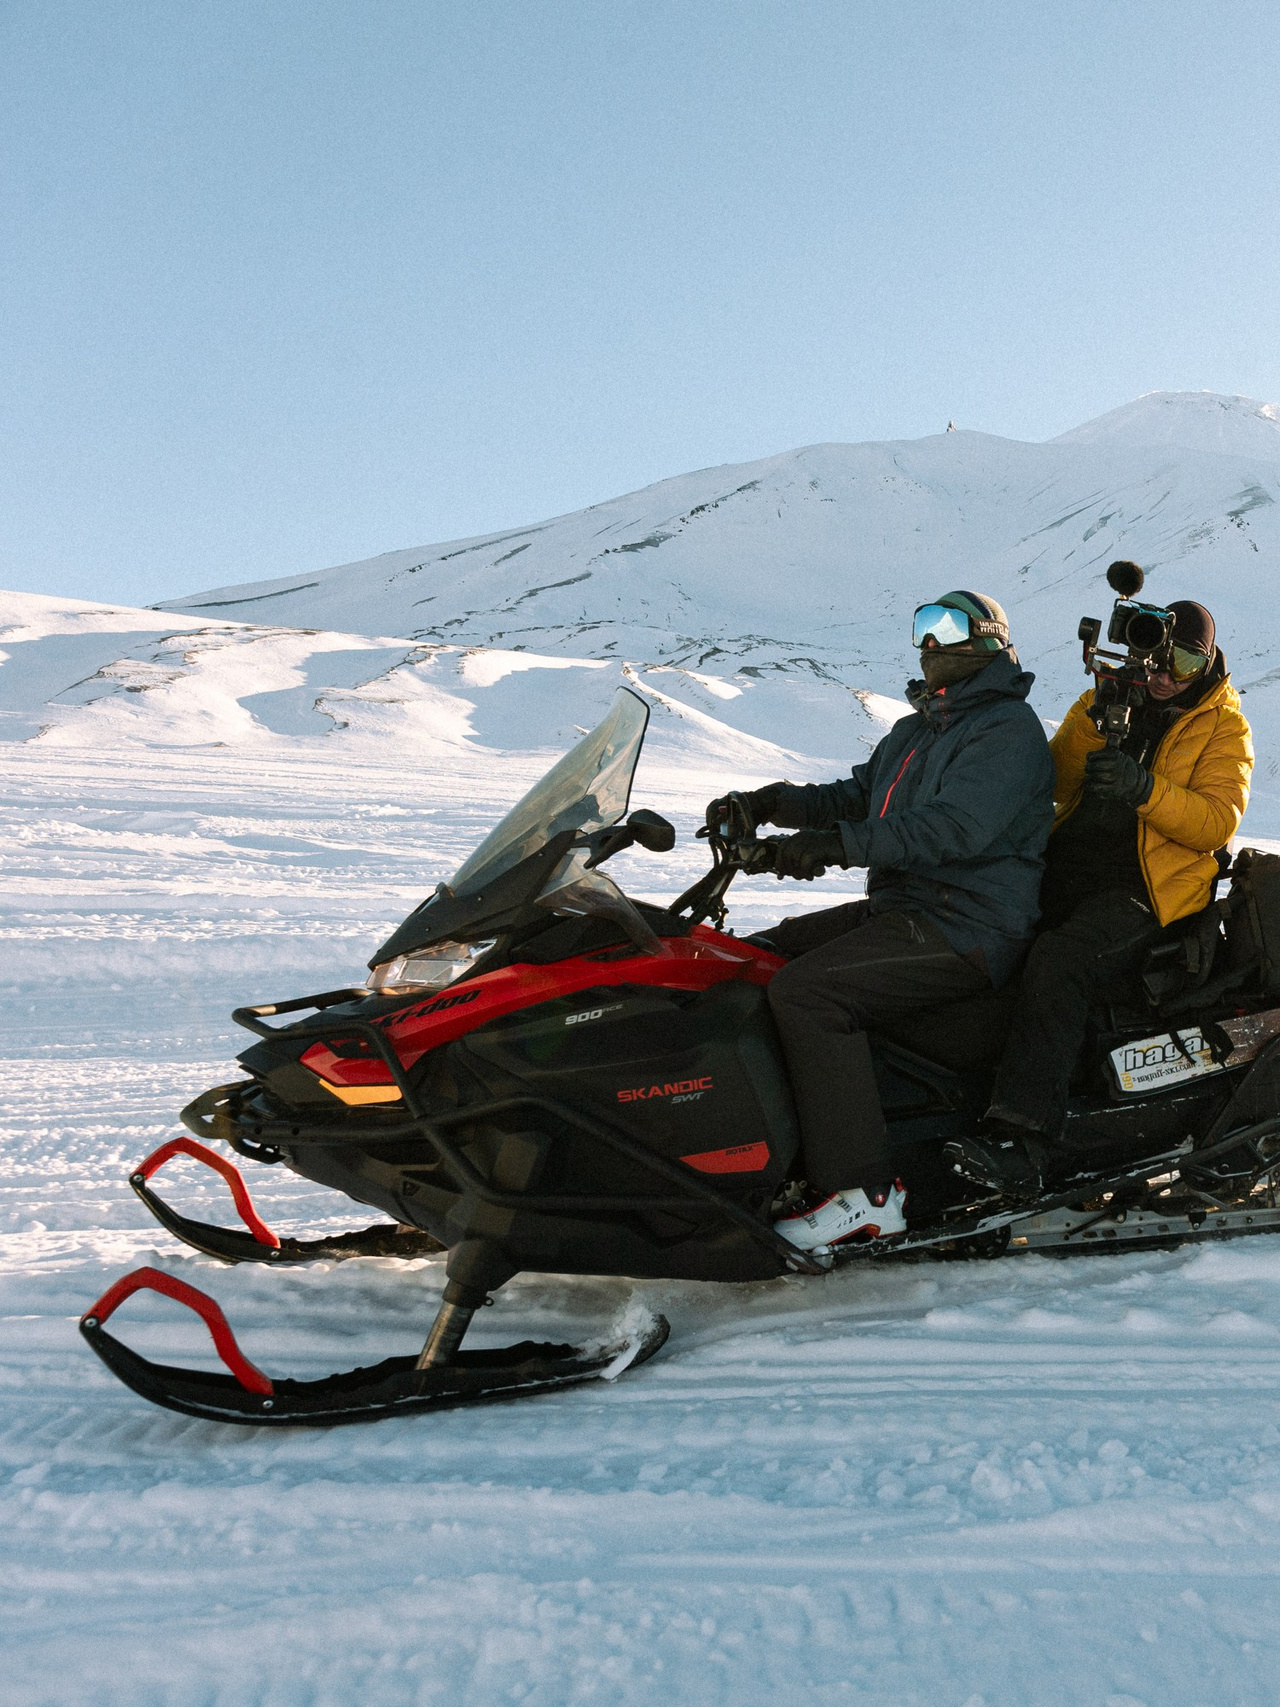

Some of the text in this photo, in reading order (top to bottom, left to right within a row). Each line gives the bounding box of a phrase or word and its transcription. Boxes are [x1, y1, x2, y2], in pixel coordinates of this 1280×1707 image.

[565, 1009, 603, 1025] 900
[1125, 1035, 1211, 1072] haga
[617, 1076, 714, 1102] SKANDIC
[671, 1092, 704, 1104] SWT
